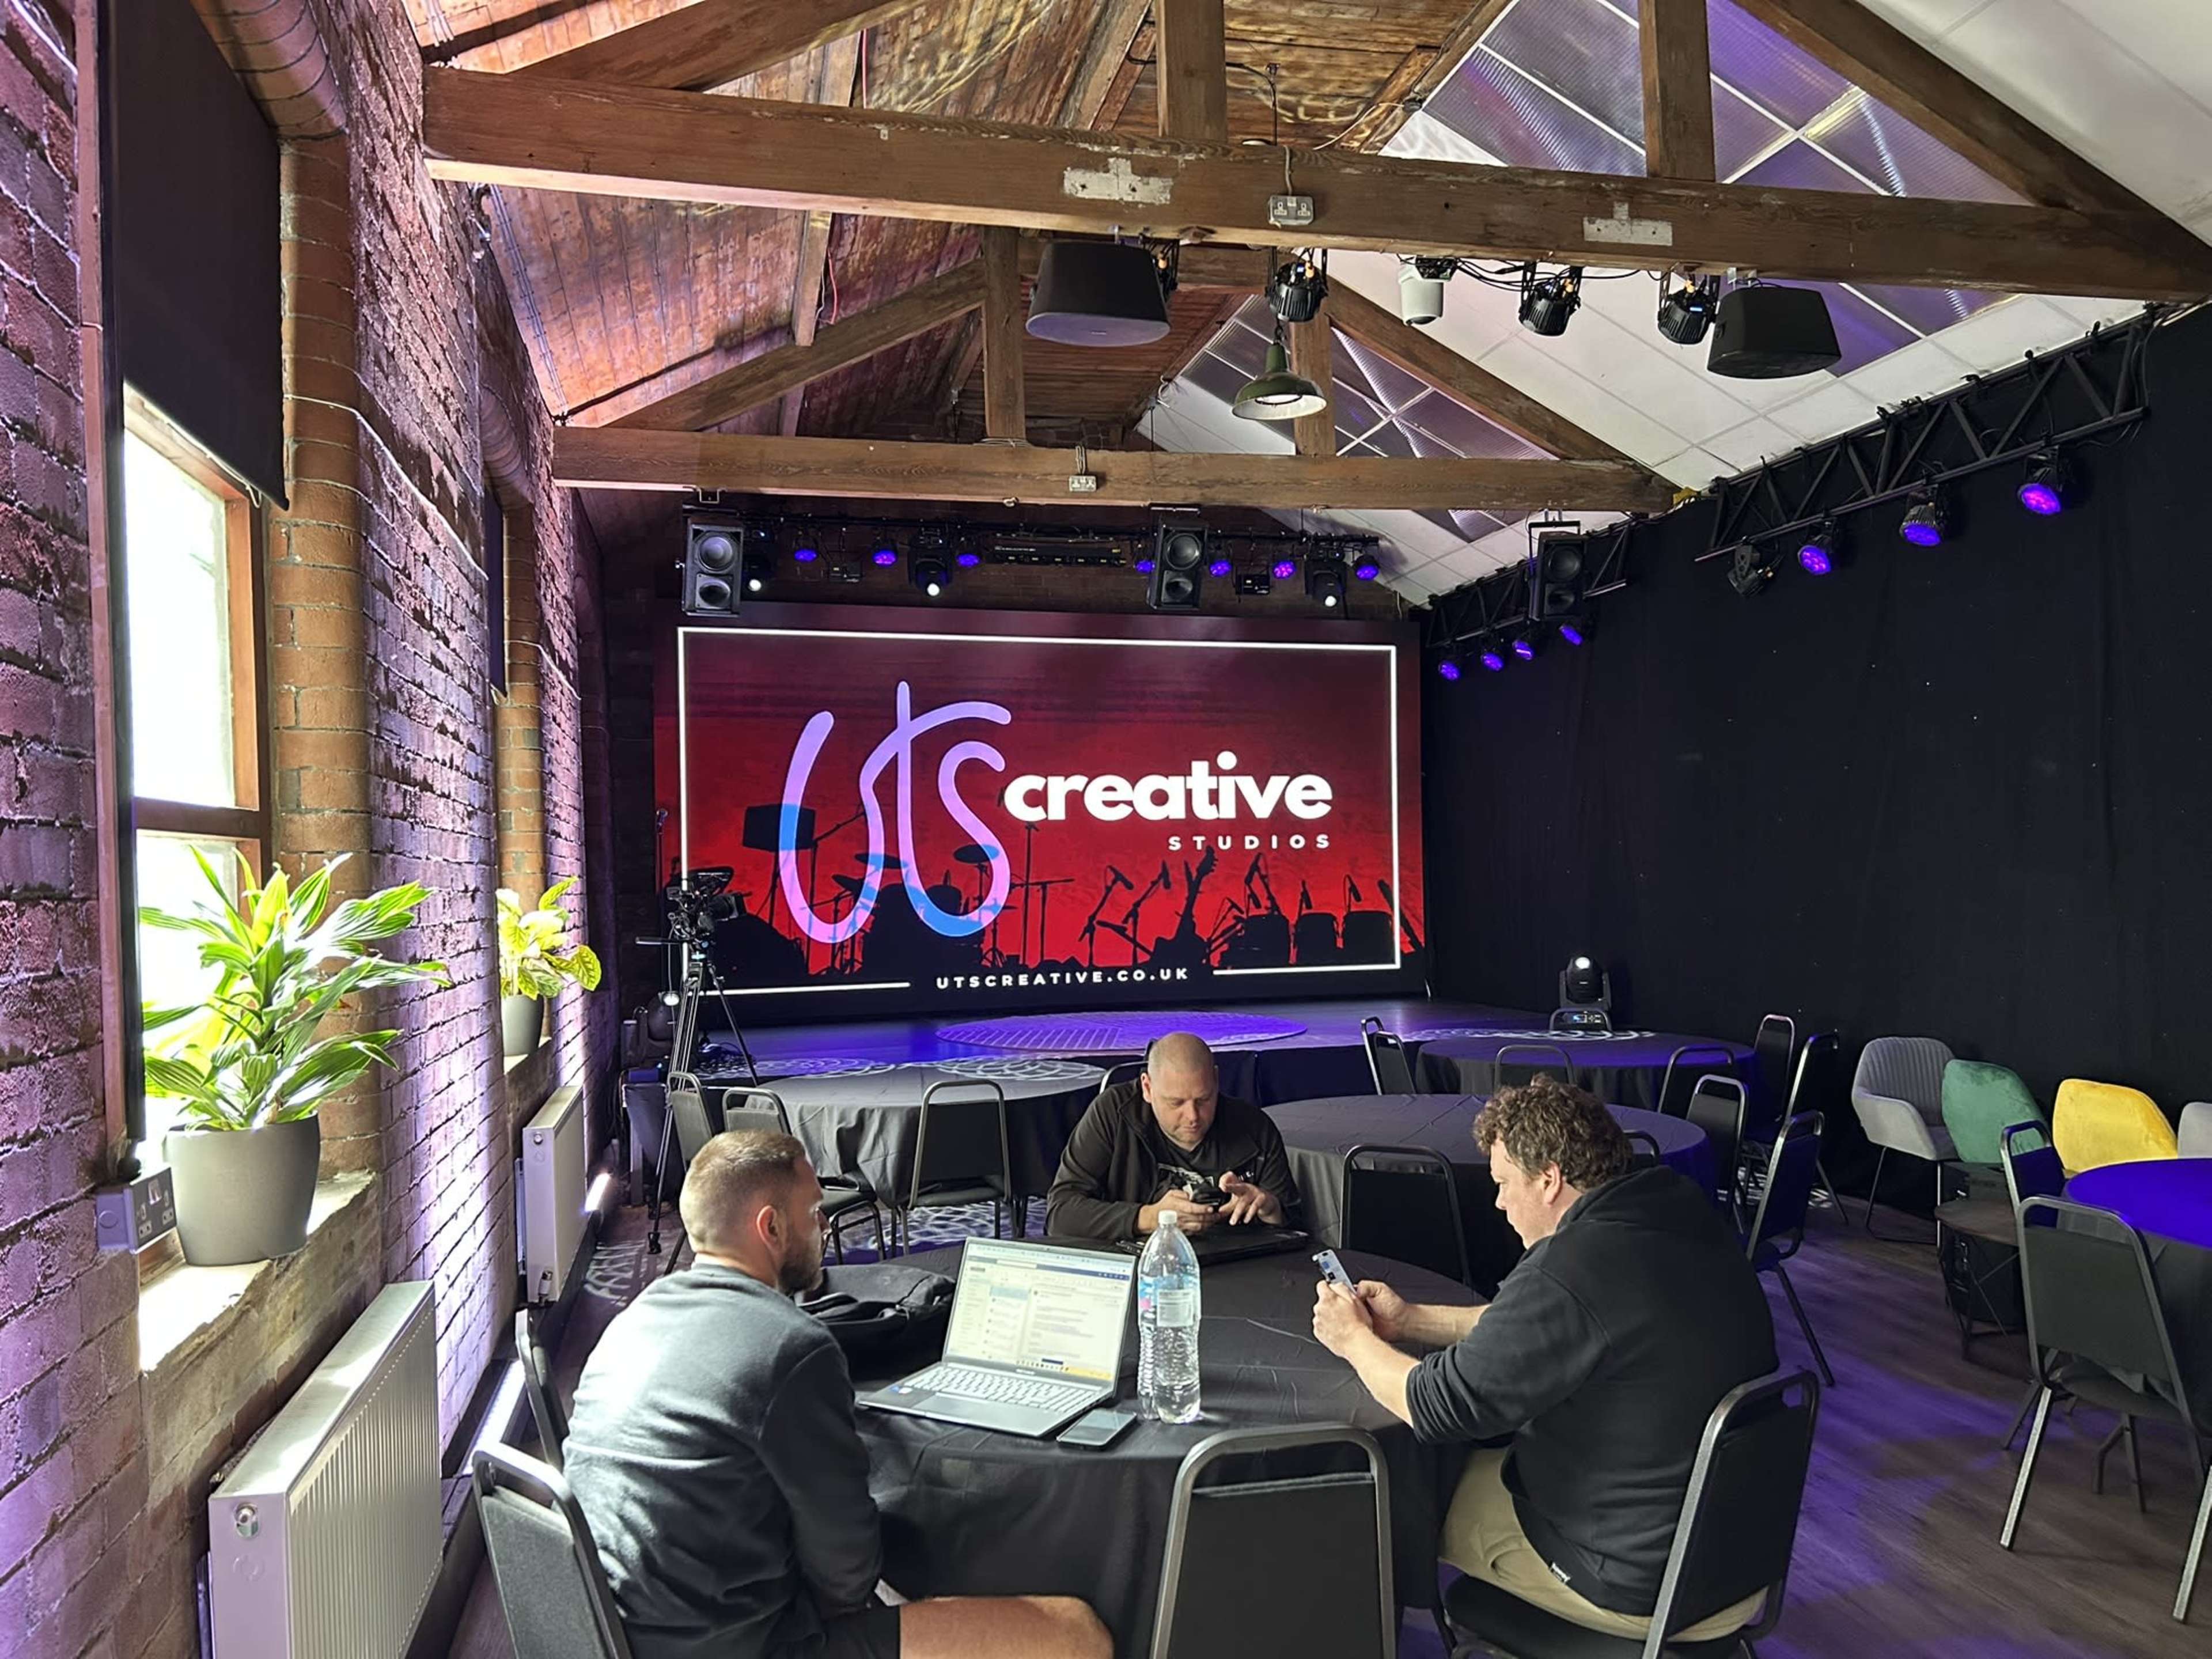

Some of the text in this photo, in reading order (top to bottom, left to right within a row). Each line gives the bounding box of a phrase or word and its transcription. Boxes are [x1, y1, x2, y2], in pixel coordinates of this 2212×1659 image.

[1004, 751, 1333, 822] creative
[1168, 833, 1330, 851] STUDIOS
[936, 968, 1188, 990] UTSCREATIVE.CO.UK
